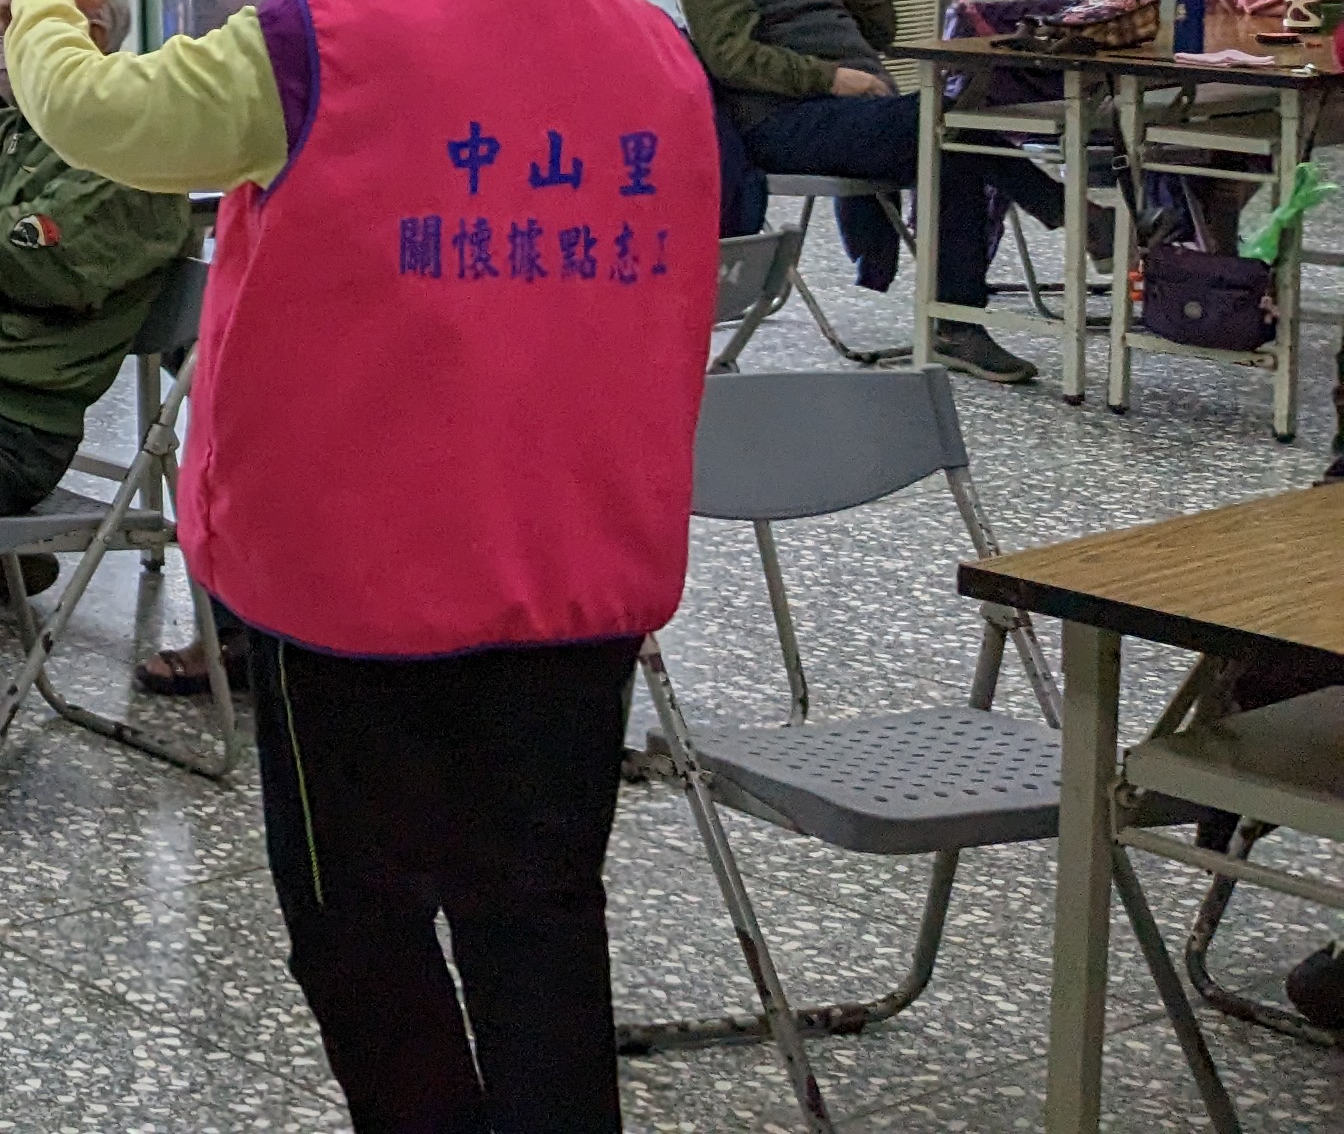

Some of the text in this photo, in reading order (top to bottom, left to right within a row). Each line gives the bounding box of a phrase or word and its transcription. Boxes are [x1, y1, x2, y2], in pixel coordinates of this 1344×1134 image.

[447, 121, 658, 196] 中山里
[400, 215, 668, 284] 關懷據點志工
